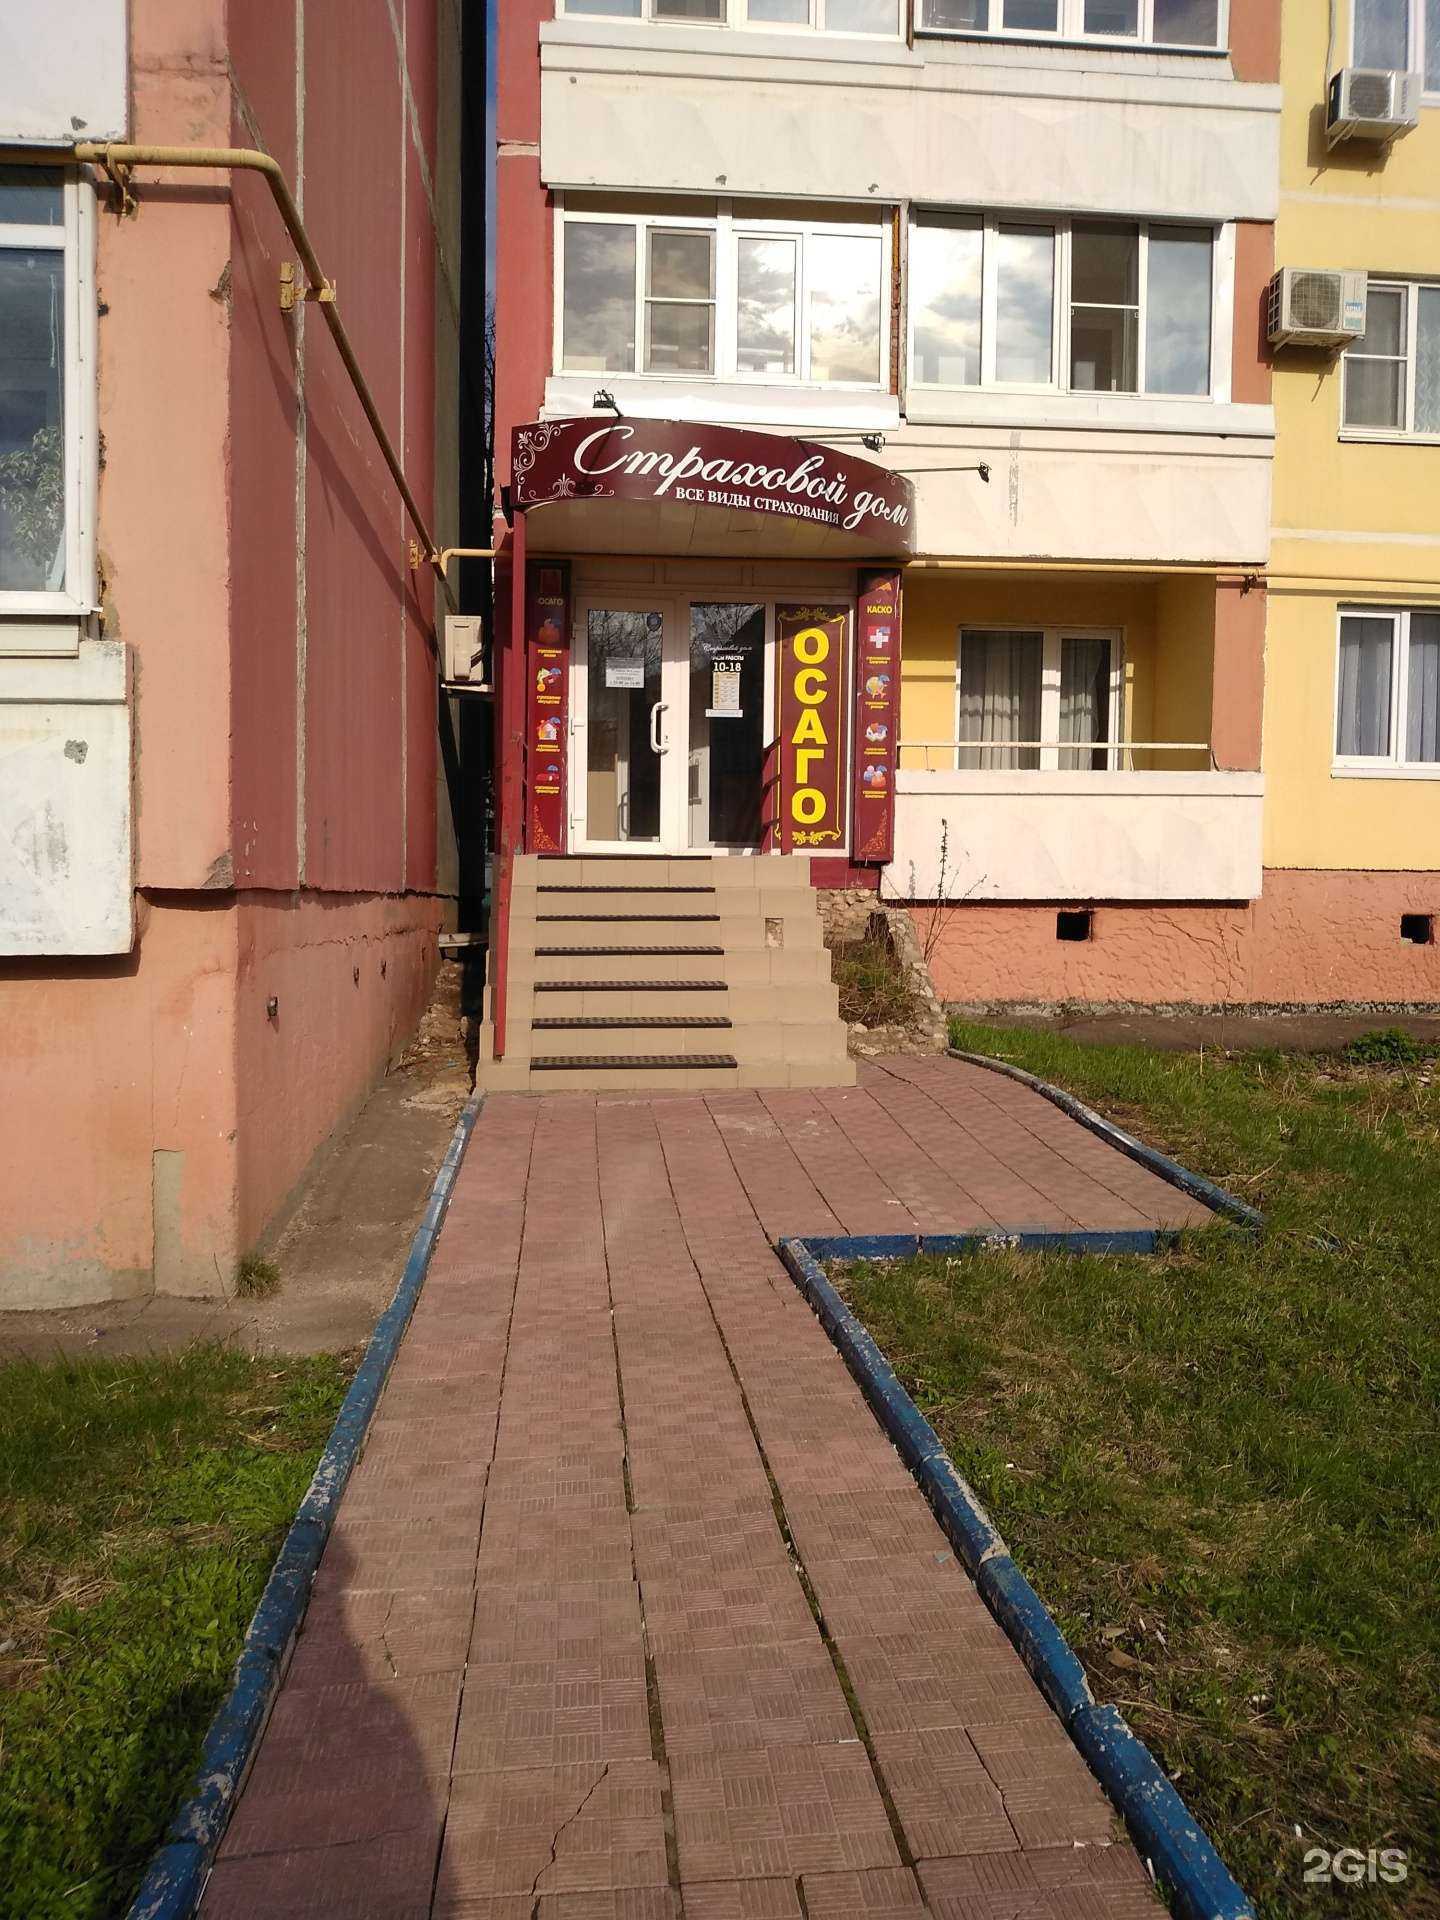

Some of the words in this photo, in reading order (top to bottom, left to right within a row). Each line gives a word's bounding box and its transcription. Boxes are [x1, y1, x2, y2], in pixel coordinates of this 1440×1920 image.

[573, 426, 848, 505] Страховой
[842, 490, 909, 530] дом
[675, 487, 704, 502] ВСЕ
[708, 489, 751, 508] ВИДЫ
[753, 497, 840, 524] СТРАХОВАНИЯ
[867, 604, 893, 615] КАСКО
[713, 661, 742, 672] 10-18
[791, 627, 830, 825] ОСАГО
